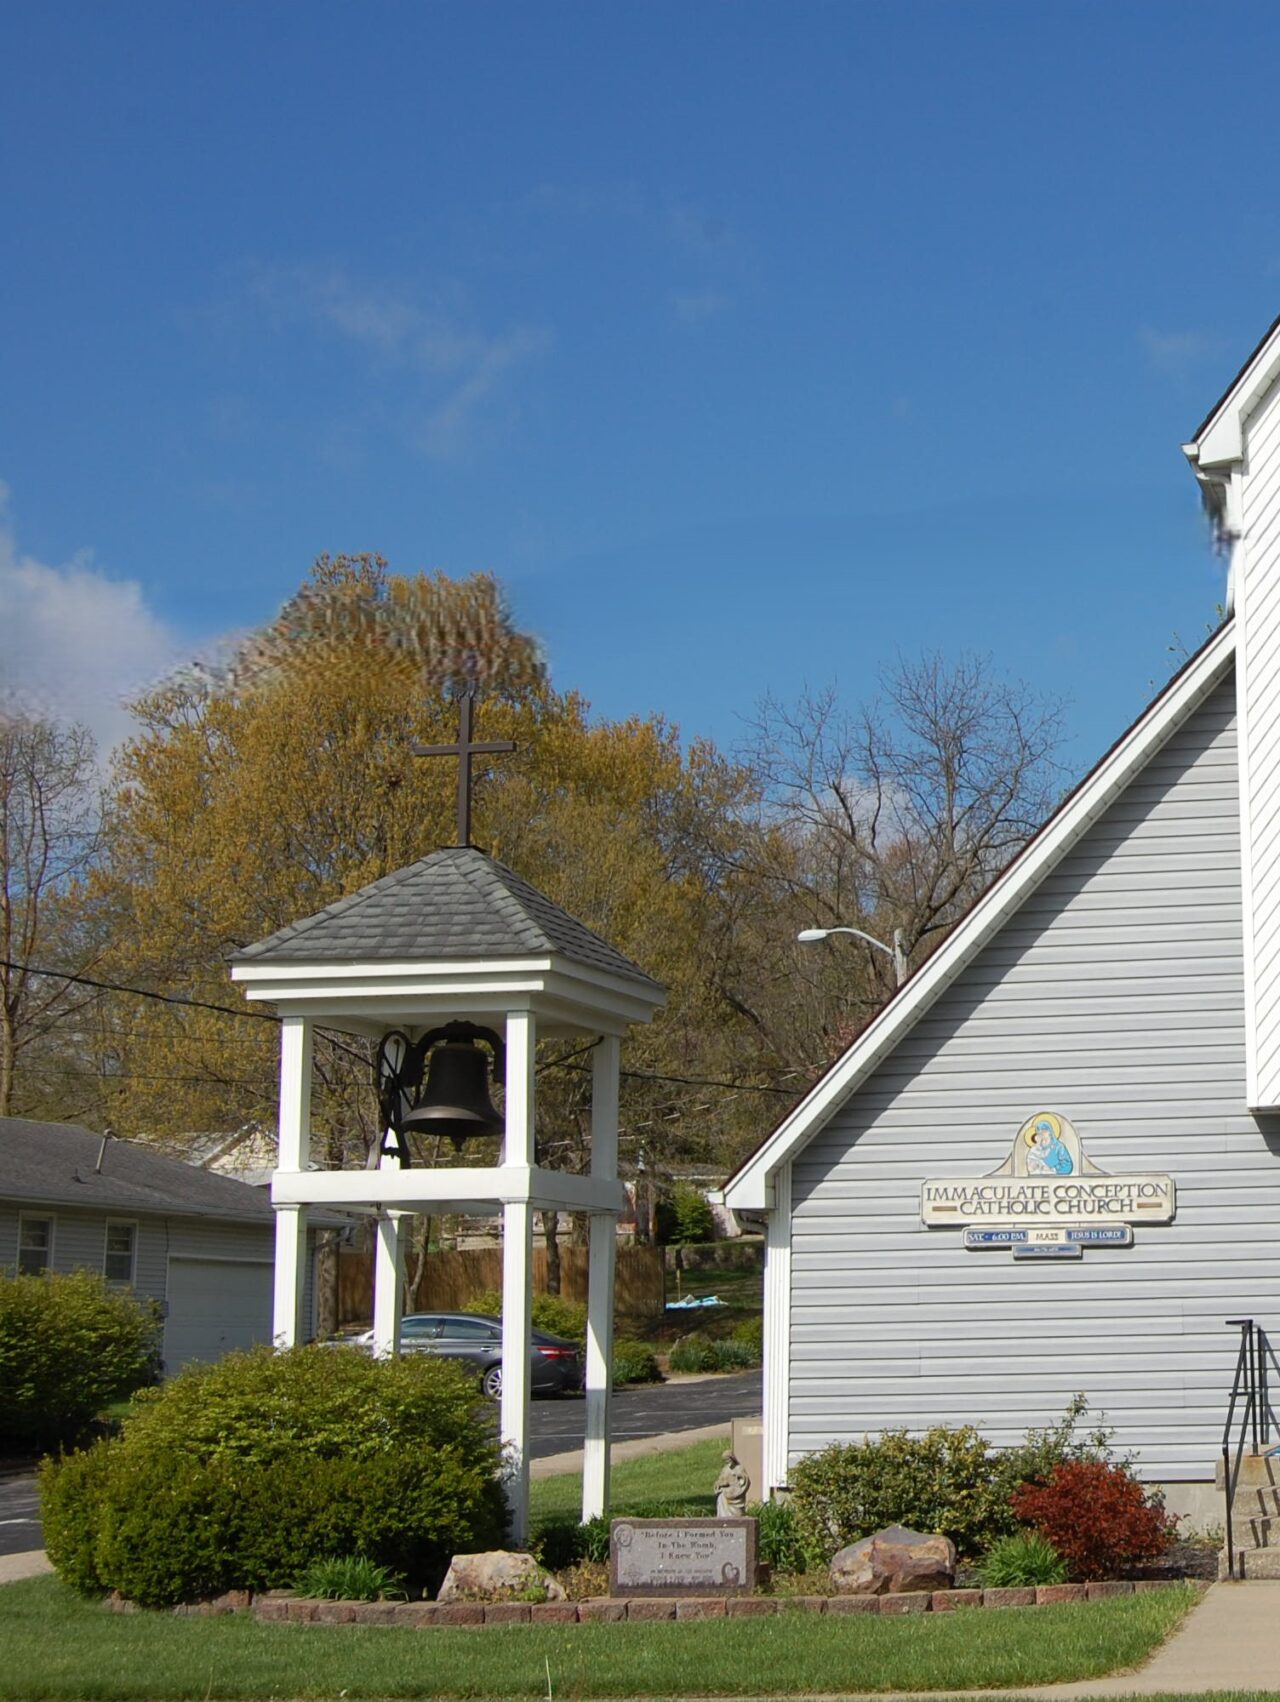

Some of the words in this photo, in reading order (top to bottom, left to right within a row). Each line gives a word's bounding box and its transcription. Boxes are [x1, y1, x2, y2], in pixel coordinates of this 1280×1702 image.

[926, 1184, 1049, 1201] IMMACULATE
[1053, 1182, 1169, 1199] CONCEPTION
[960, 1200, 1050, 1216] CATHOLIC
[1054, 1199, 1134, 1215] CHURCH
[1036, 1232, 1059, 1241] MASS
[1071, 1231, 1090, 1240] JESUS
[1091, 1231, 1097, 1239] IS
[684, 1530, 716, 1538] Formed
[719, 1530, 734, 1538] You
[658, 1541, 667, 1549] In
[671, 1541, 686, 1549] The
[669, 1551, 693, 1559] Knew
